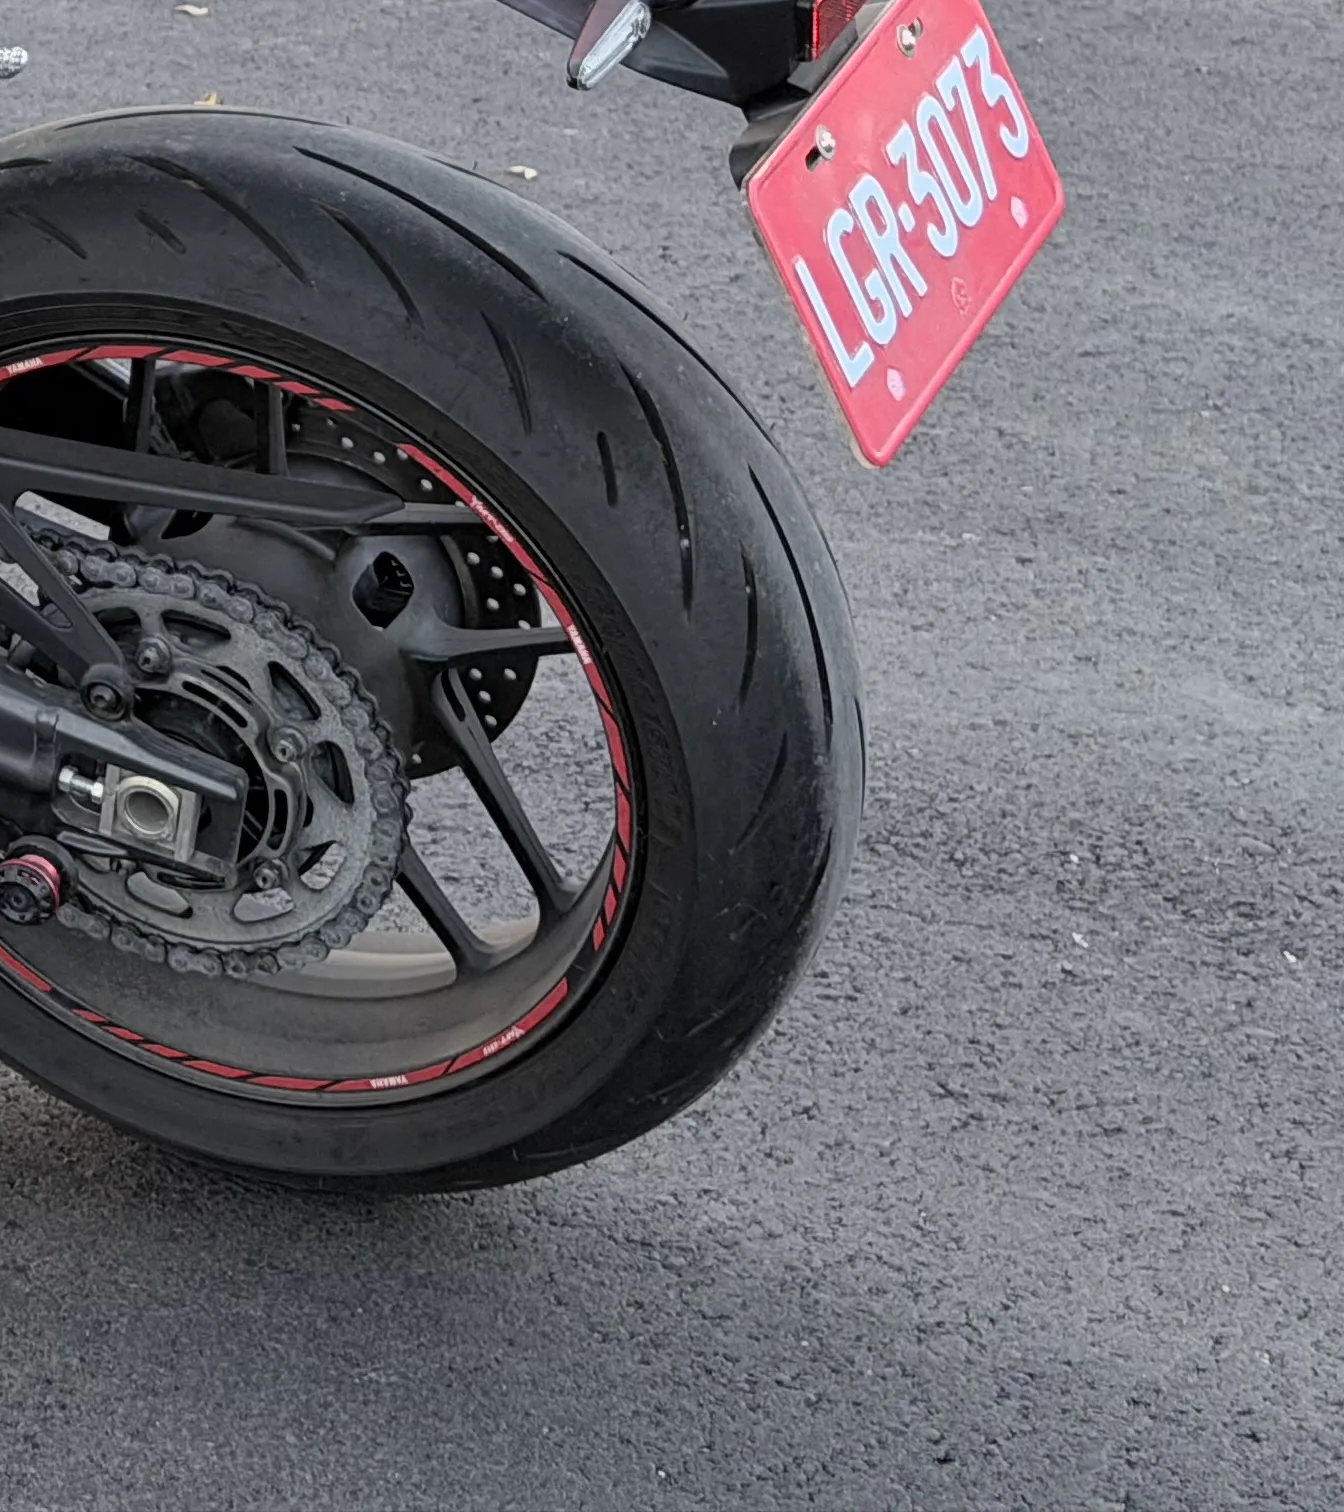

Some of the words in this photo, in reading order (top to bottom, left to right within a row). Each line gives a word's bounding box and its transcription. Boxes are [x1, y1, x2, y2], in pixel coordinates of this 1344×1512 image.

[794, 28, 1030, 387] LGR-3073
[5, 356, 43, 376] YAMAHA
[567, 624, 593, 665] YAMAHA
[368, 1074, 409, 1089] YAMAHA
